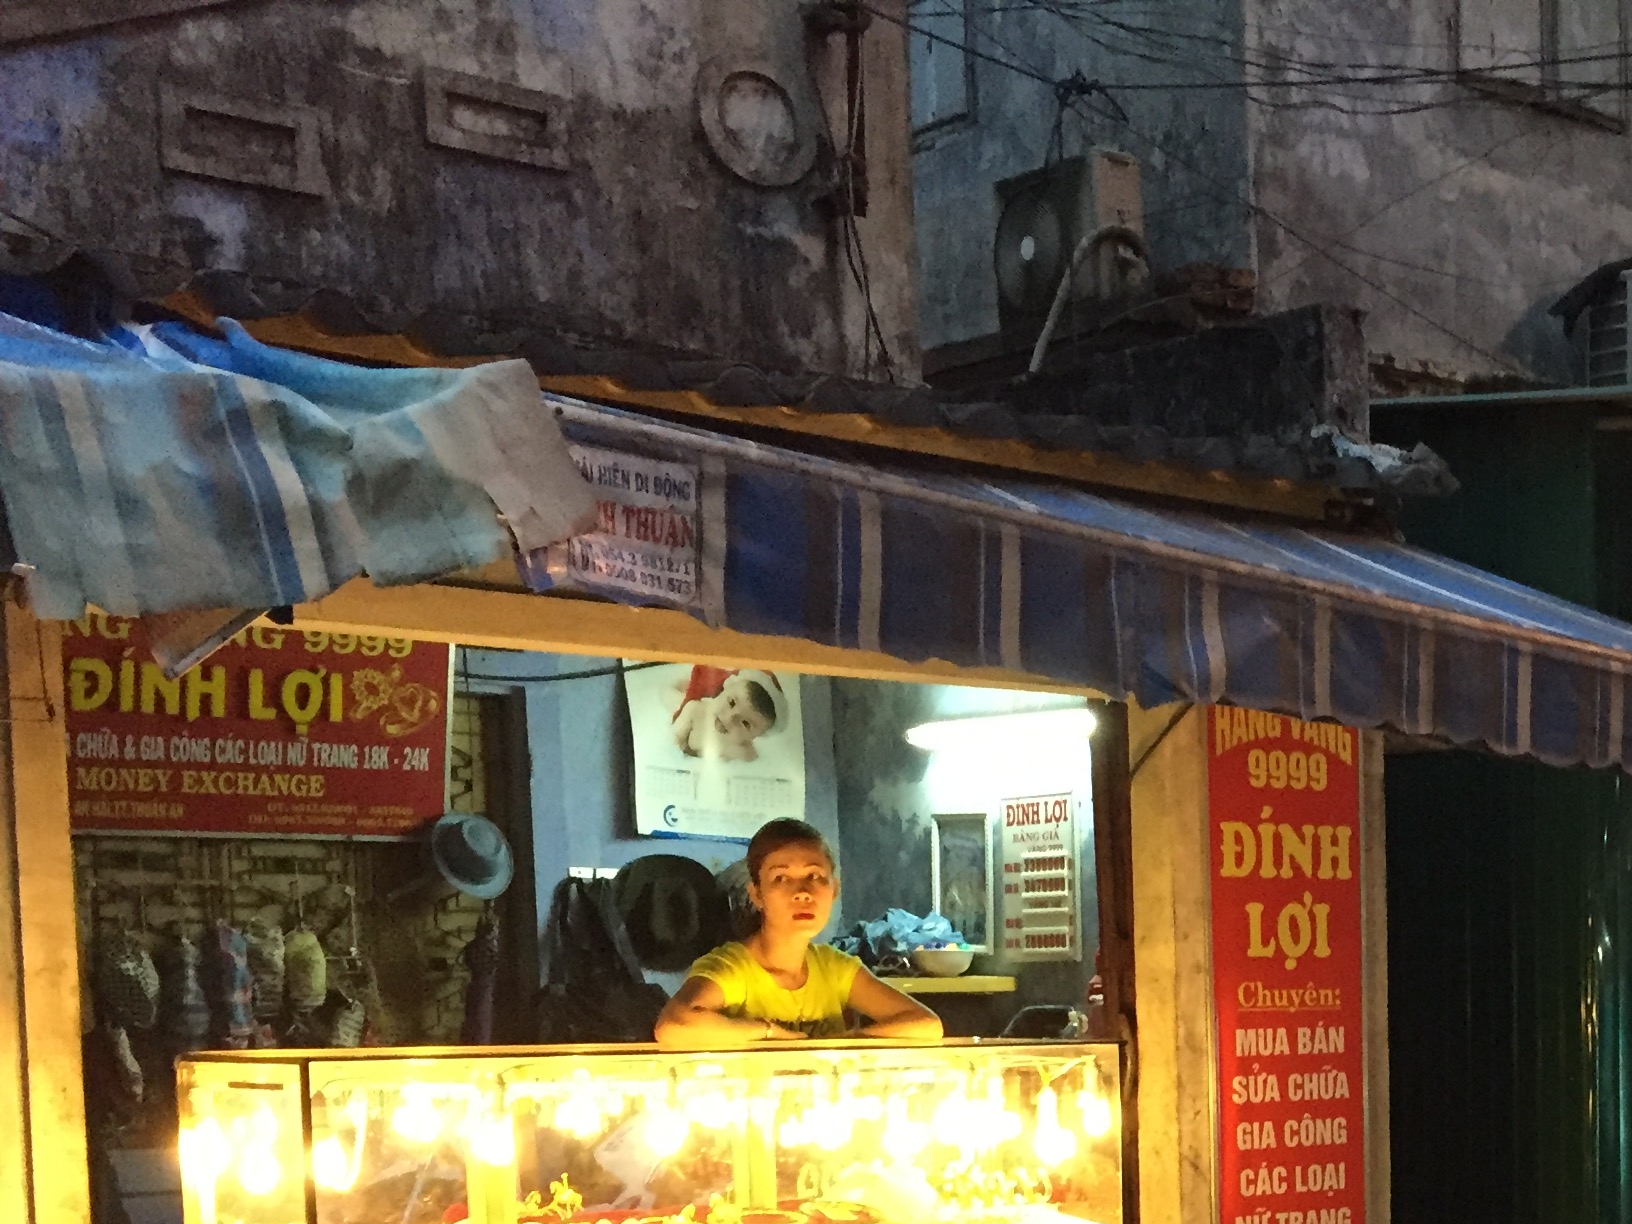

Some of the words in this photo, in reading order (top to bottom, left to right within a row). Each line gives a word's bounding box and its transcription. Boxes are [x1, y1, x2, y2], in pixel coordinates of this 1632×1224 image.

[69, 645, 226, 721] ĐÍNH
[248, 664, 343, 736] LỢI
[140, 735, 165, 762] GIA
[170, 730, 211, 763] CÔNG
[215, 731, 245, 764] CÁC
[249, 739, 283, 770] LOẠI
[312, 742, 358, 769] TRANG
[363, 745, 389, 770] 18K
[402, 746, 430, 771] 24K
[1248, 748, 1328, 792] 9999
[76, 767, 173, 793] MONEY
[181, 770, 326, 798] EXCHANGE
[1219, 805, 1353, 880] ĐÍNH
[1245, 890, 1332, 971] LỢI
[1235, 1027, 1290, 1057] MUA
[1297, 1021, 1345, 1056] BÁN
[1232, 1063, 1281, 1105] SỬA
[1288, 1064, 1350, 1101] CHỮA
[1236, 1120, 1277, 1151] GIA
[1284, 1112, 1348, 1148] CÔNG
[1240, 1161, 1288, 1197] CÁC
[1295, 1161, 1346, 1197] LOẠI
